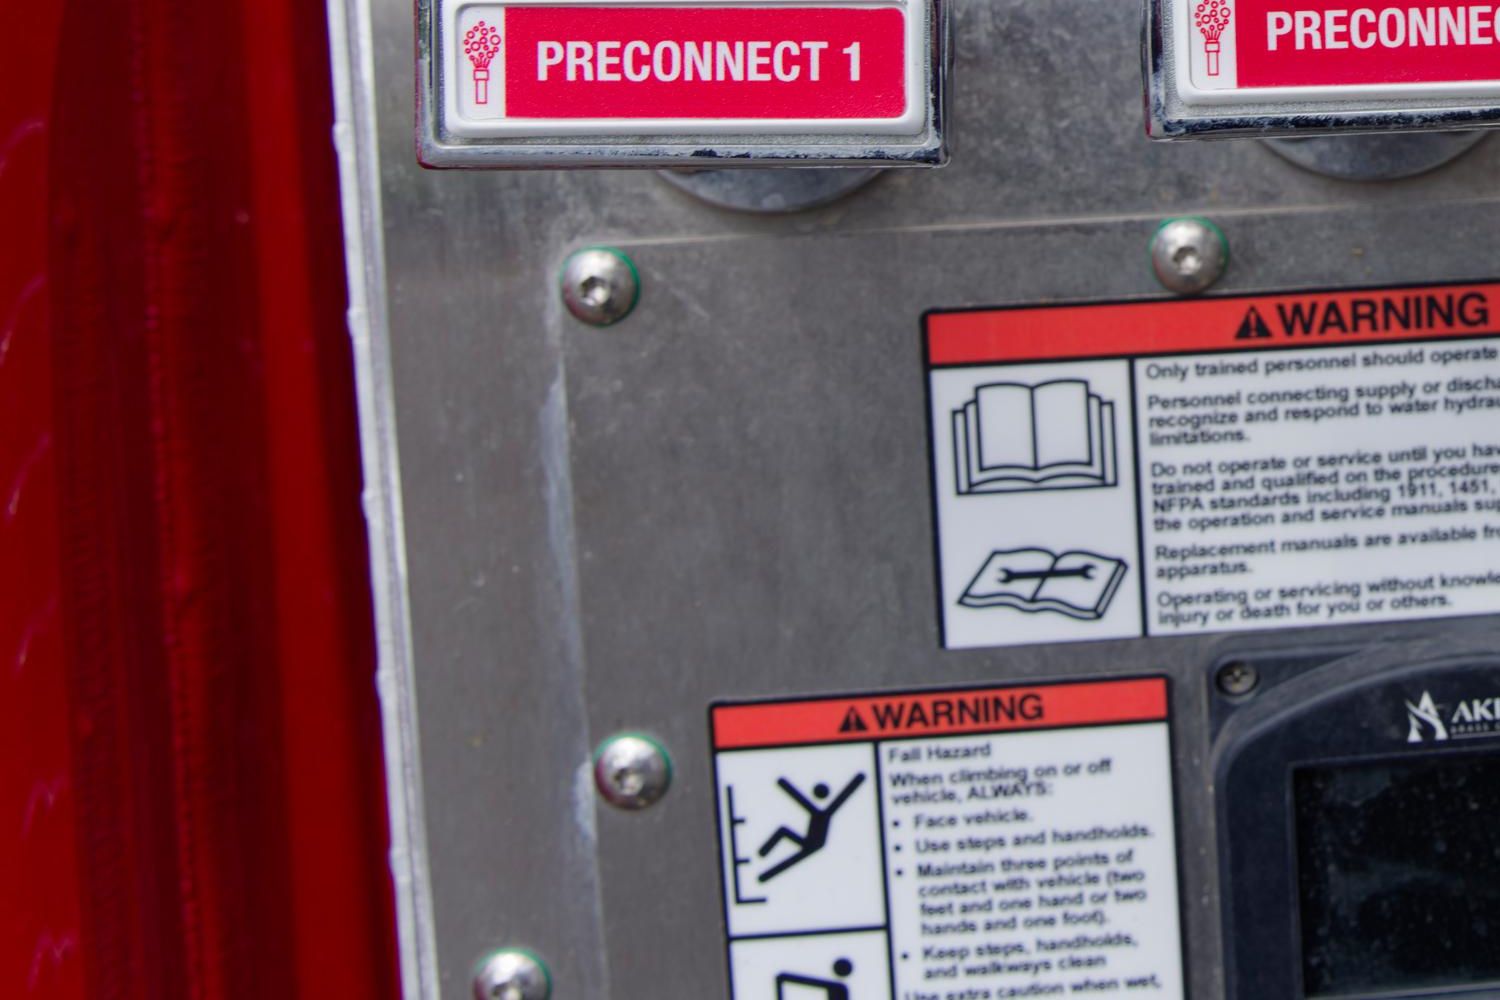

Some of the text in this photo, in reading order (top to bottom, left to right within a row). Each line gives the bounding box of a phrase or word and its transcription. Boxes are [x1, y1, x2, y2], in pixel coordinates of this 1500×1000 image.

[537, 41, 861, 81] PRECONNECT 1
[1276, 292, 1490, 337] WARNING
[1144, 362, 1189, 383] Only
[1193, 358, 1259, 376] trained
[1263, 352, 1358, 376] personnel
[1360, 349, 1425, 366] should
[1429, 344, 1499, 366] operate
[1146, 390, 1242, 410] Personnel
[1246, 384, 1350, 408] connecting
[1354, 380, 1416, 401] supply
[1422, 382, 1440, 393] or
[1147, 409, 1239, 433] recognize
[1243, 406, 1279, 423] and
[1283, 401, 1360, 424] respond
[1364, 400, 1383, 415] to
[1388, 397, 1438, 414] water
[1146, 426, 1252, 446] limitations.
[1150, 496, 1205, 514] NFPA
[1206, 490, 1302, 510] standards
[1304, 484, 1393, 508] including
[1154, 538, 1276, 564] Replacement
[1280, 533, 1358, 552] manuals
[1364, 534, 1392, 546] are
[1397, 525, 1477, 544] available
[1153, 558, 1256, 583] apparatus.
[1156, 587, 1249, 611] Operating
[1253, 589, 1272, 600] or
[1276, 579, 1362, 603] servicing
[1365, 574, 1435, 593] without
[1157, 591, 1455, 628] injury or death for you or others.
[872, 694, 1044, 731] WARNING
[886, 742, 992, 762] Fall Hazard
[889, 758, 1111, 787] When climbing on or off
[912, 811, 958, 828] Face
[914, 837, 951, 853] Use
[955, 833, 1007, 854] steps
[1011, 830, 1047, 846] and
[916, 848, 1133, 877] Maintain three points of
[922, 942, 970, 964] Keep
[923, 951, 1106, 980] and walkways clean
[997, 981, 1064, 999] caution
[1071, 977, 1120, 994] when
